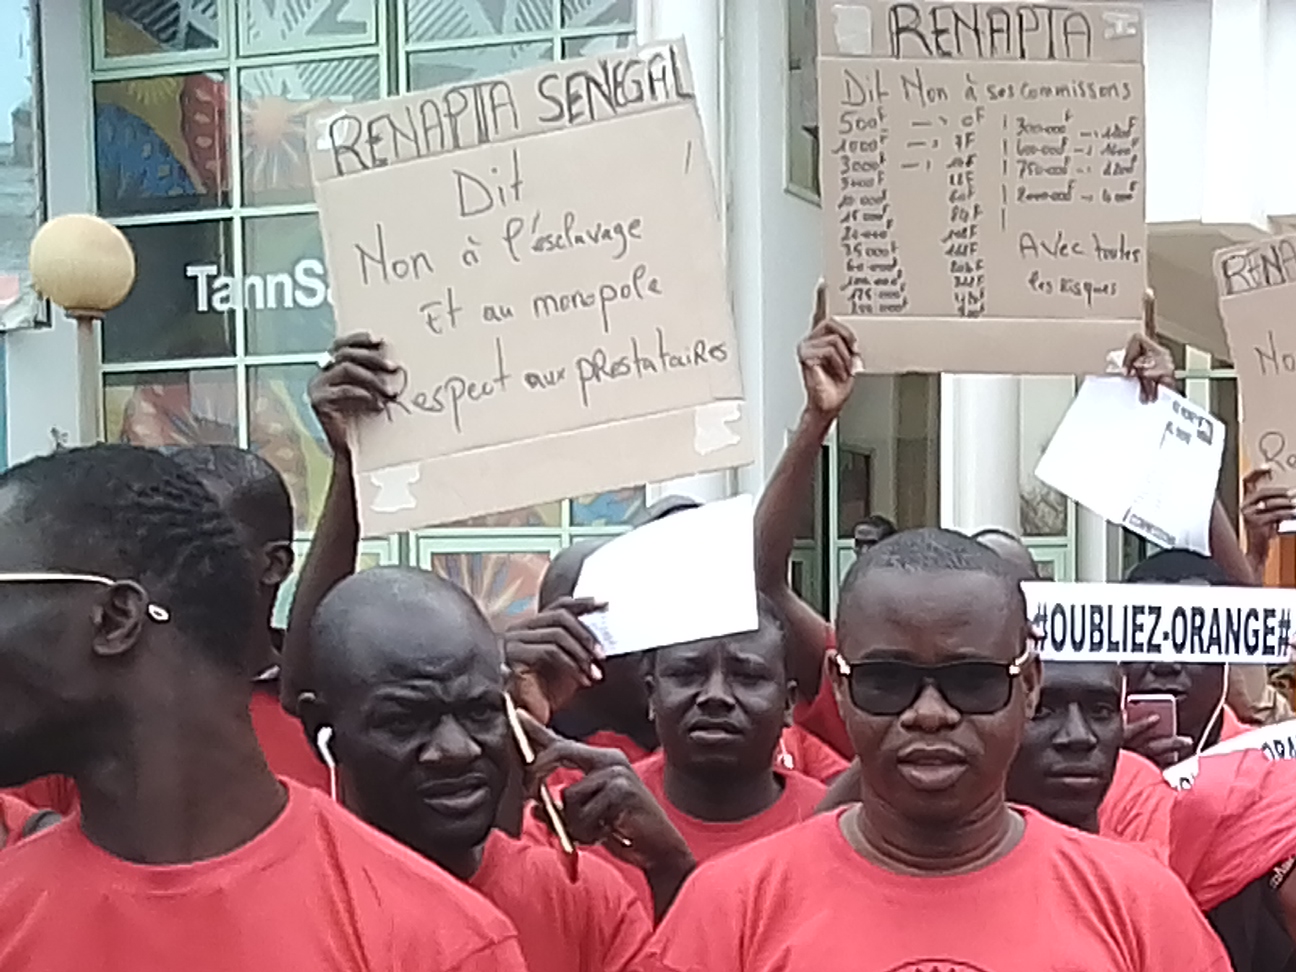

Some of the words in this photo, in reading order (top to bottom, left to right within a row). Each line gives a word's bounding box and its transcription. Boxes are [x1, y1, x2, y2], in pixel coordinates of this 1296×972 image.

[889, 3, 1091, 60] RENAPTA
[328, 81, 520, 176] RENAPTA
[538, 45, 694, 125] SENEGAL
[841, 68, 889, 107] Dit
[900, 68, 948, 108] Non
[453, 149, 523, 217] Dit
[356, 224, 433, 285] Non
[186, 258, 333, 313] TannS
[483, 300, 515, 321] au
[524, 367, 567, 390] aux
[1034, 601, 1291, 657] #OUBLIEZ-ORANGE#
